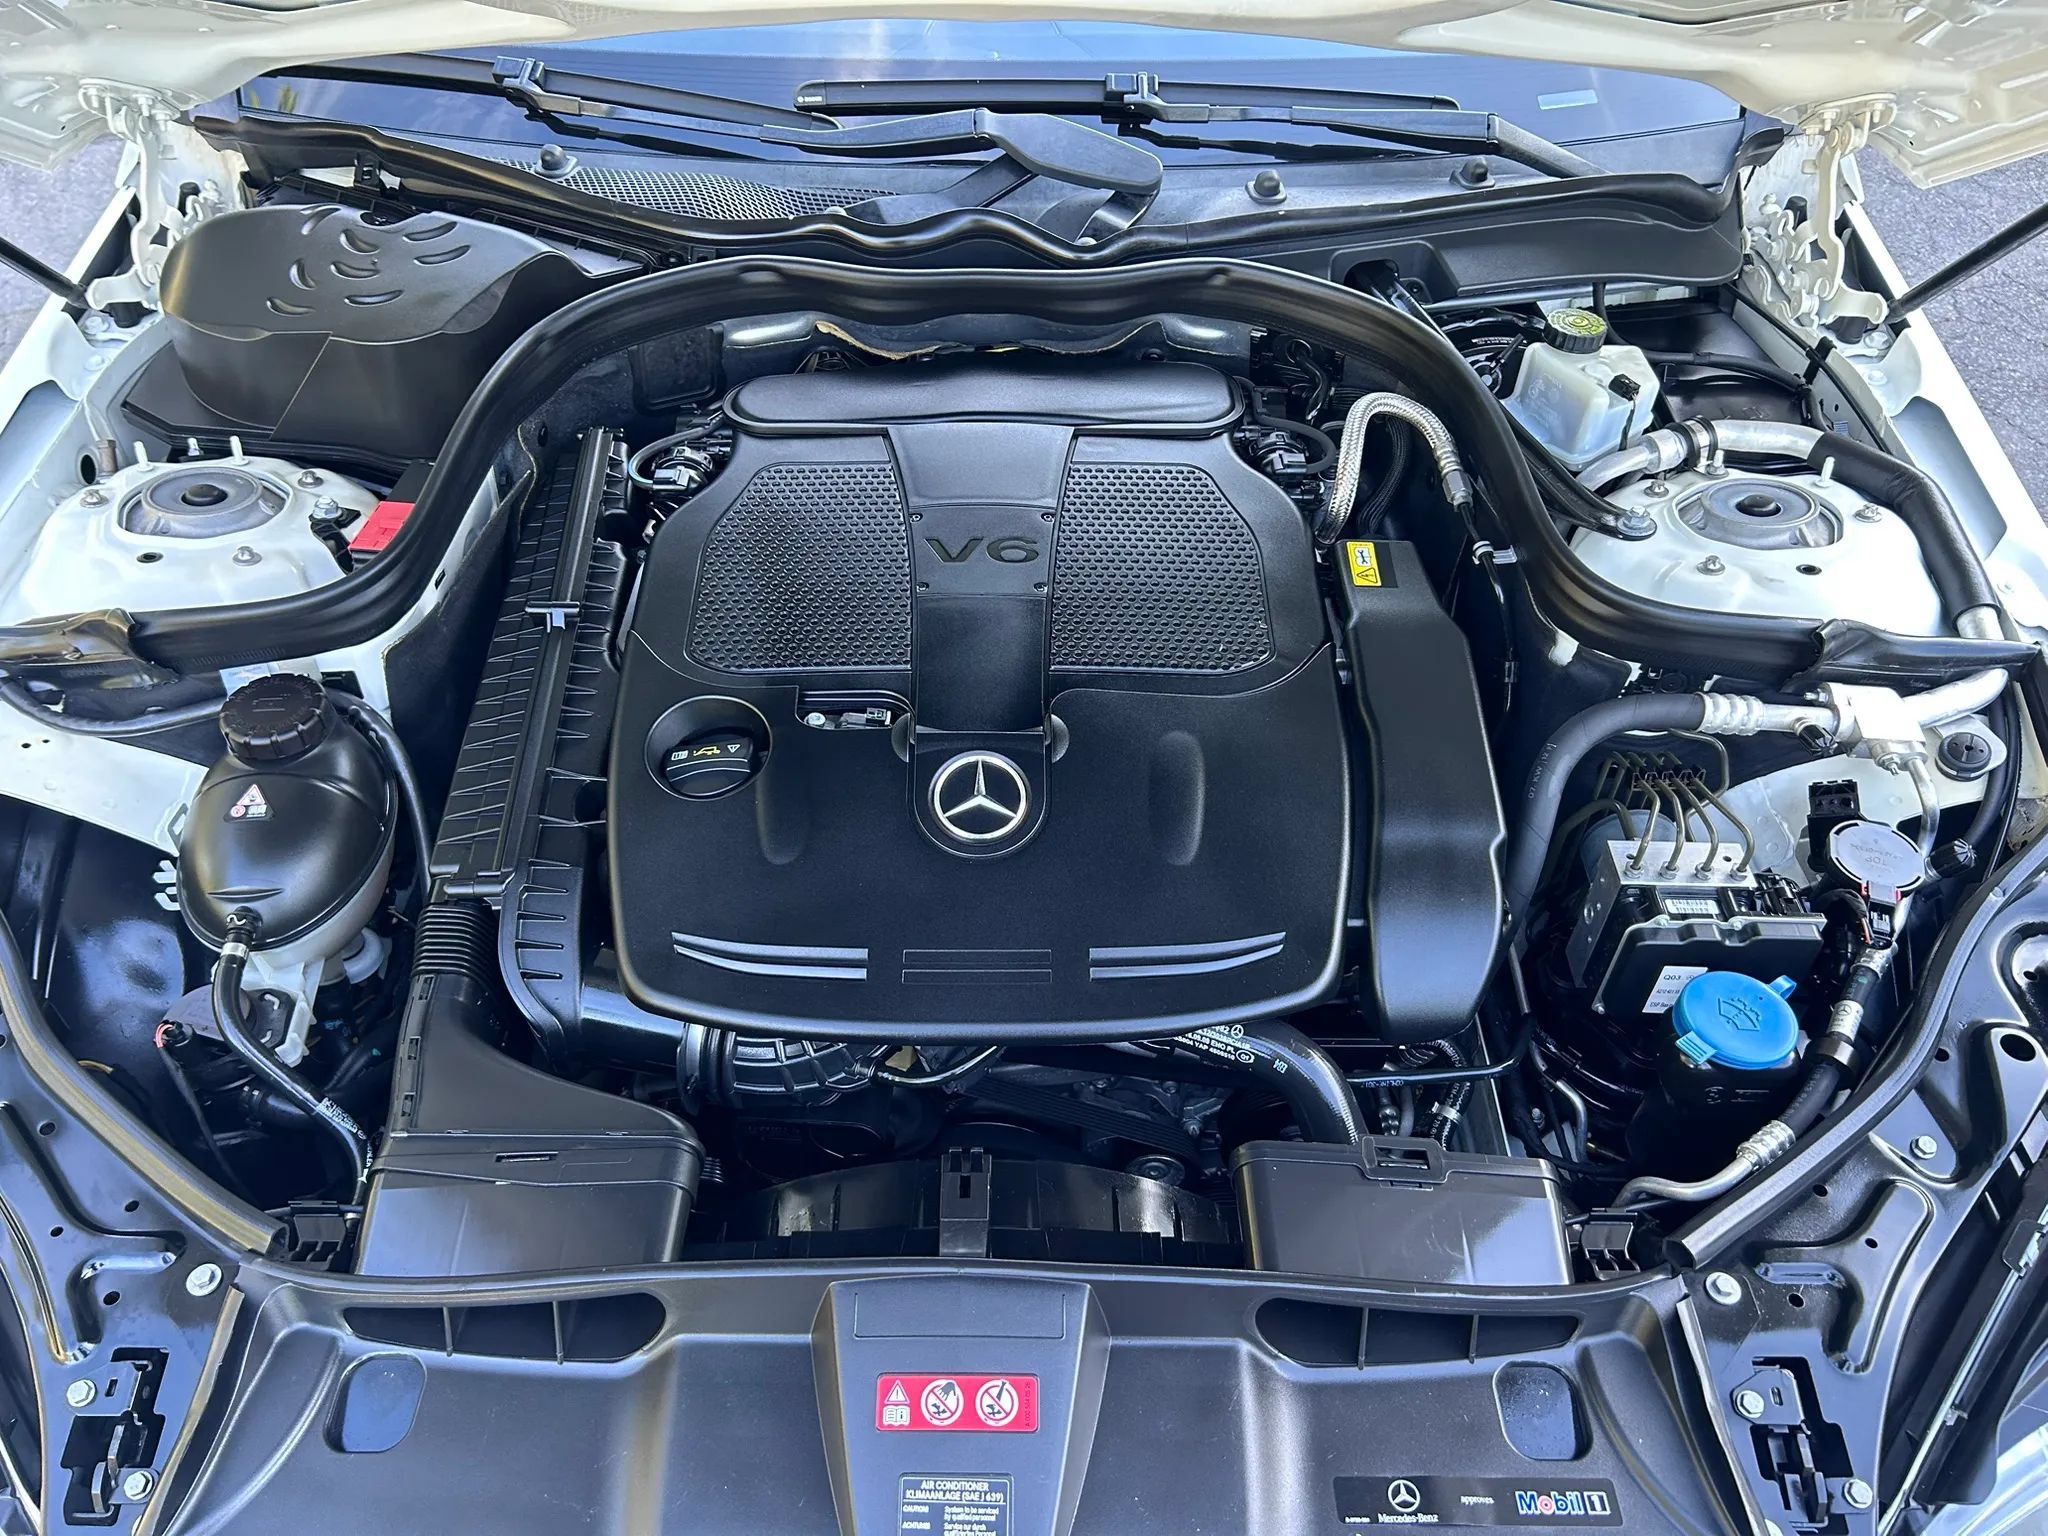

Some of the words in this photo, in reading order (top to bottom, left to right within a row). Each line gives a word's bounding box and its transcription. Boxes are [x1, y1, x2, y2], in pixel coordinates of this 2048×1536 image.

[922, 537, 1039, 563] V6
[920, 1480, 935, 1490] AIR
[935, 1480, 989, 1491] CONDITIONER
[905, 1489, 961, 1500] KLIMAANLAGE
[962, 1490, 980, 1502] (SAE
[985, 1492, 1004, 1503] 639)
[1460, 1495, 1495, 1506] approves
[1515, 1491, 1585, 1515] Mobil
[1378, 1513, 1438, 1523] Mercedes-Benz
